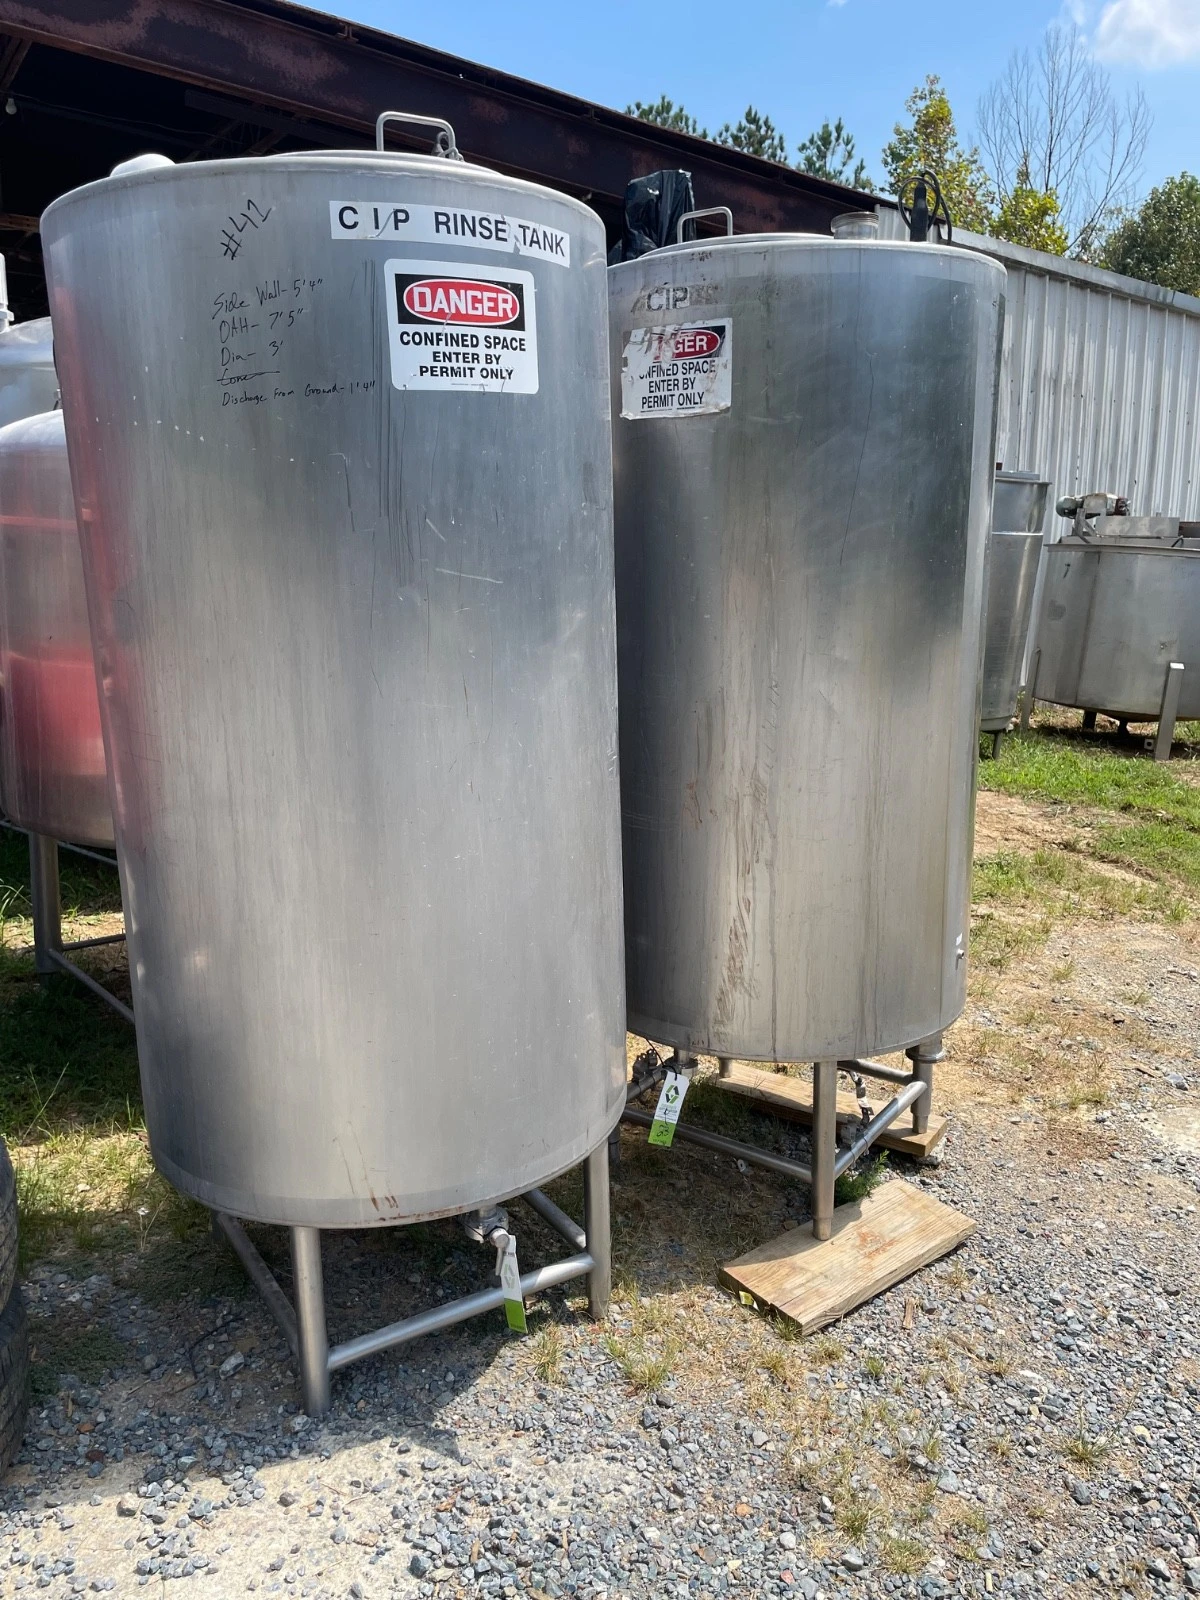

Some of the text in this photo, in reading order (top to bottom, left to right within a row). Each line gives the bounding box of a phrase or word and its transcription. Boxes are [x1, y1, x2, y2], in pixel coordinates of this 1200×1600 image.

[221, 199, 272, 260] #42
[434, 211, 508, 242] RINSE
[518, 224, 565, 257] TANK
[212, 292, 250, 320] Side
[412, 286, 514, 318] DANGER
[647, 287, 688, 311] CIP
[400, 331, 526, 352] CONFINED SPACE
[432, 351, 502, 365] ENTER BY
[681, 360, 716, 375] SPACE
[419, 366, 514, 380] PERMIT ONLY
[648, 377, 696, 393] ENTER BY
[641, 393, 676, 409] PERMIT
[678, 391, 705, 406] ONLY
